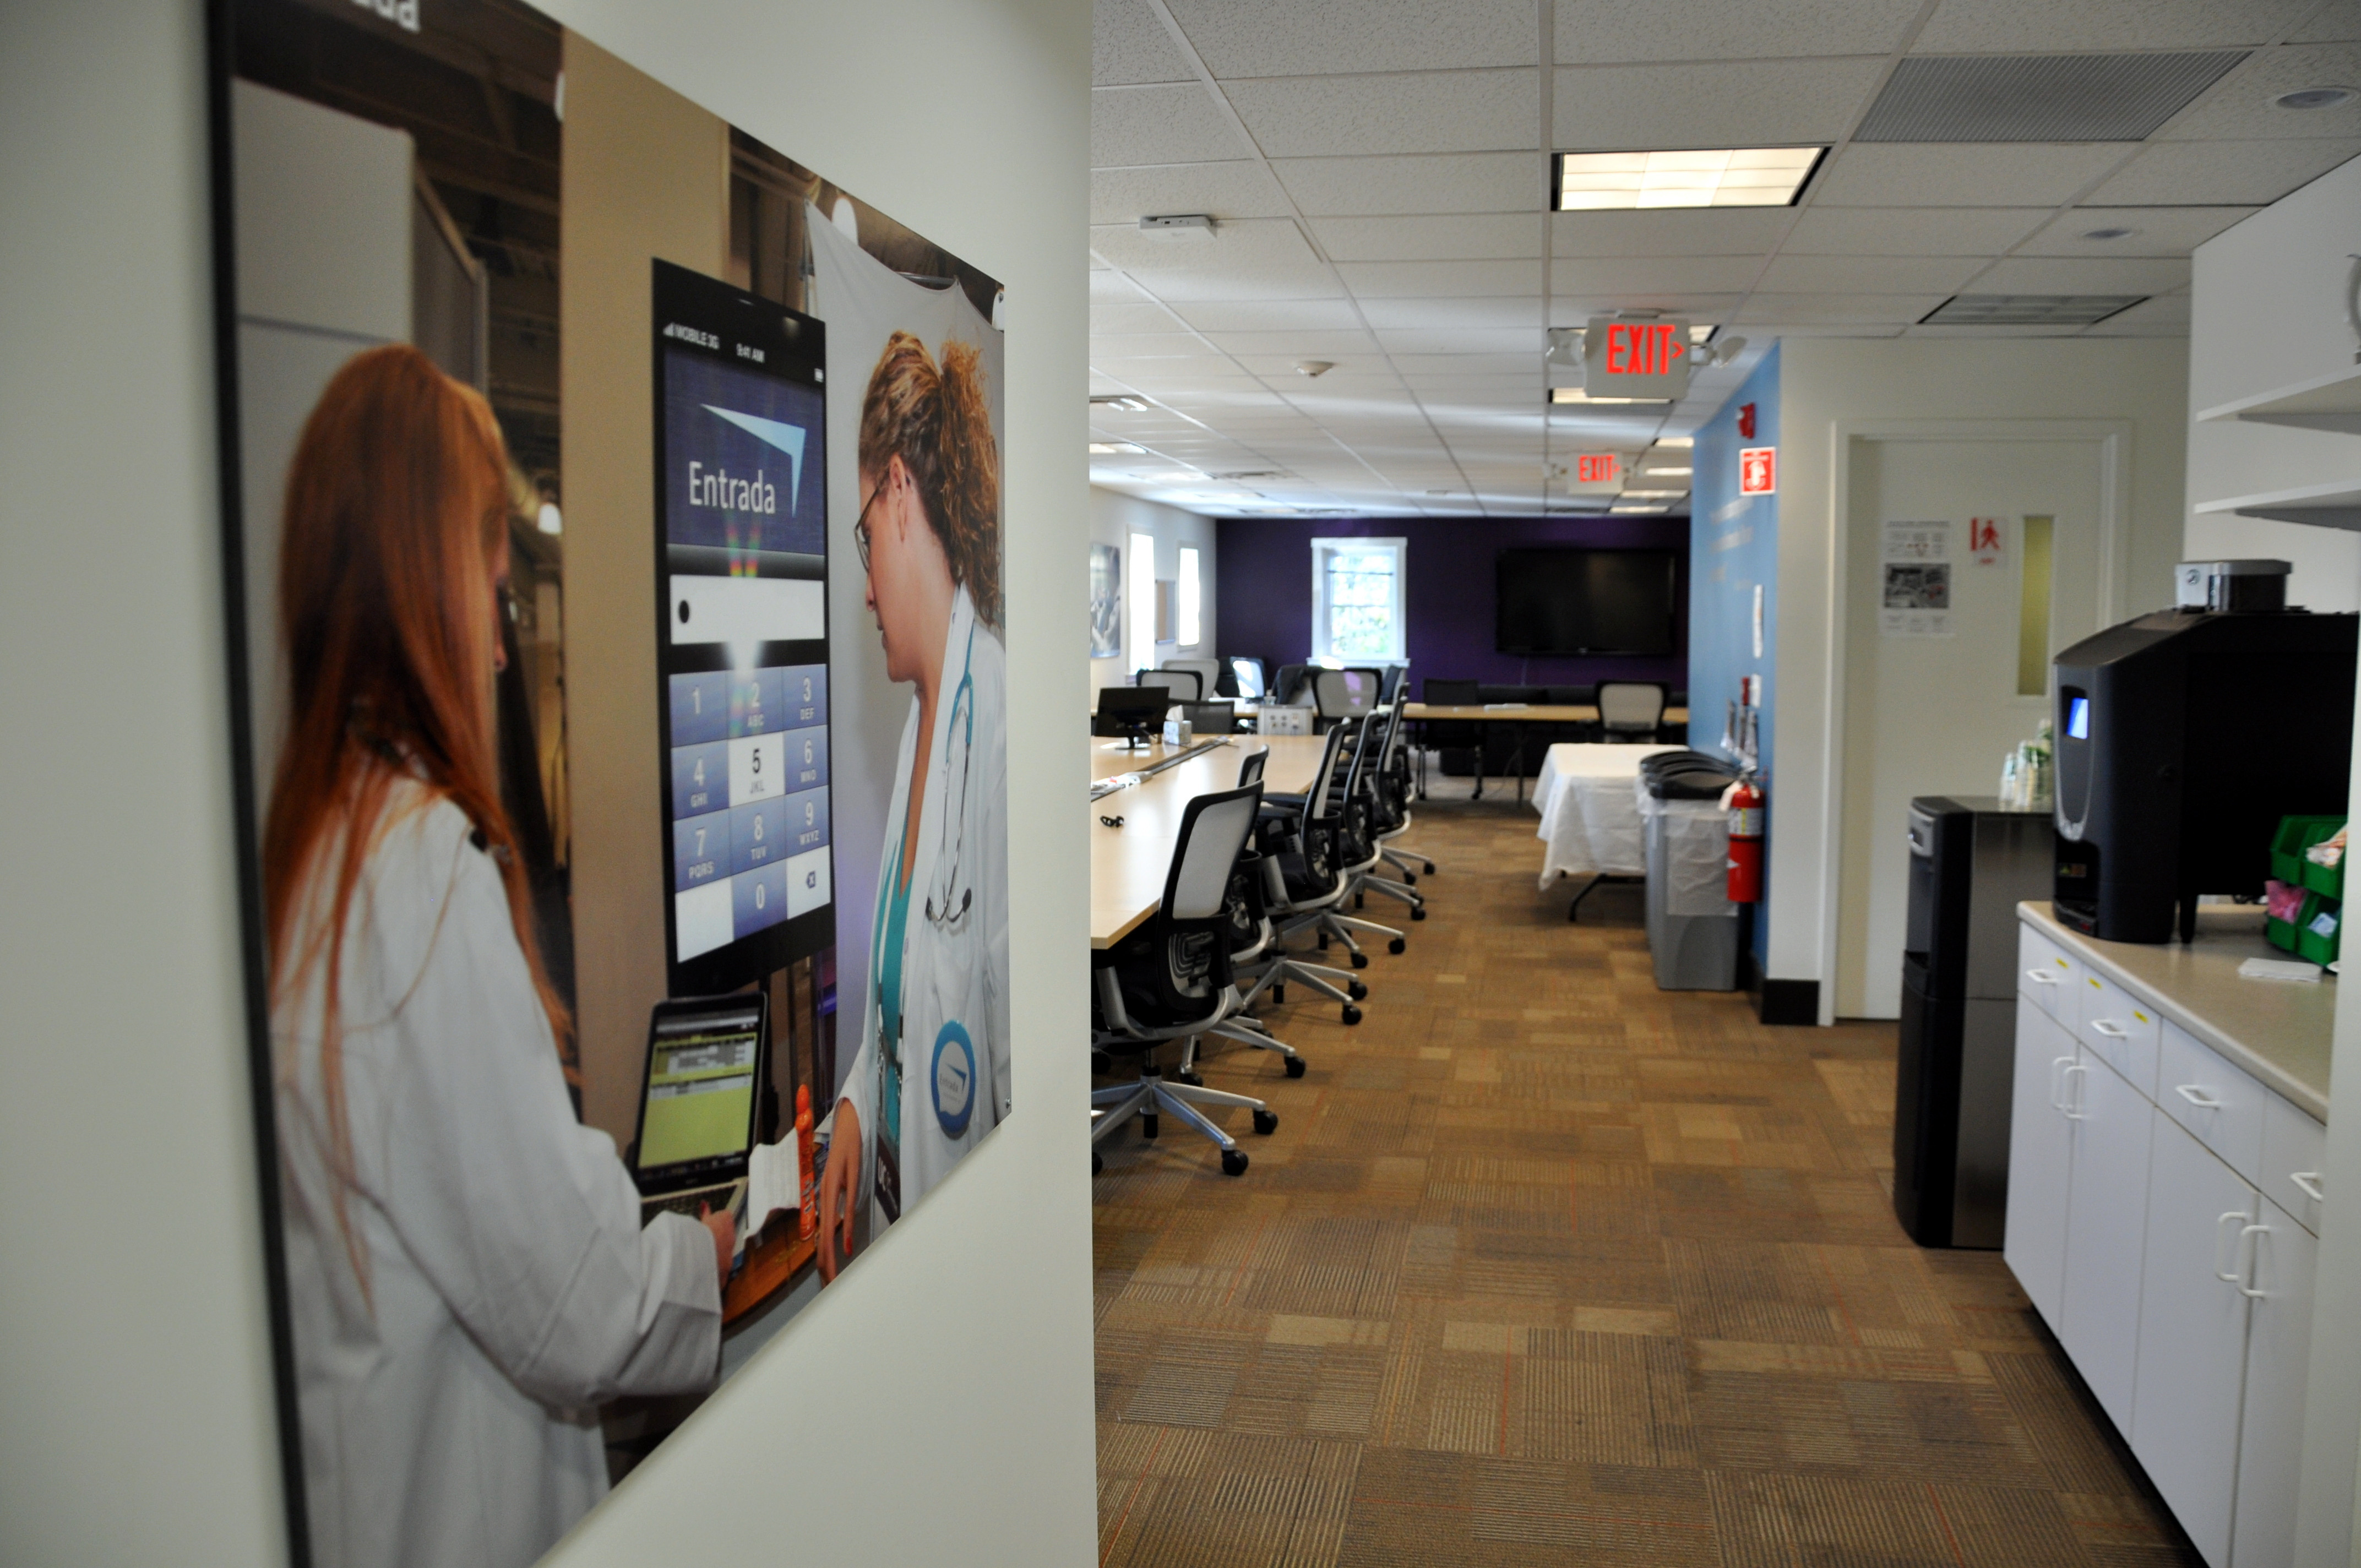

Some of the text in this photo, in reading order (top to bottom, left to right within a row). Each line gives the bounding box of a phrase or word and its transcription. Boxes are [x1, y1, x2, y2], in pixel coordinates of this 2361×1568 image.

[1606, 324, 1675, 375] EXIT
[1579, 455, 1615, 482] EXIT
[688, 461, 776, 514] Entrada
[692, 686, 701, 714] 1
[750, 682, 760, 708] 2
[803, 676, 812, 702] 3
[747, 714, 764, 727] ABC
[799, 707, 814, 721] DEF
[752, 748, 761, 775] 5
[804, 738, 813, 765] 6
[693, 756, 704, 786] 4
[690, 791, 708, 808] GHI
[749, 780, 765, 794] JKL
[805, 800, 814, 826] 9
[754, 813, 763, 841] 8
[695, 827, 706, 857] 7
[750, 845, 767, 861] TUV
[689, 860, 714, 880] PQRS
[755, 882, 765, 910] 0
